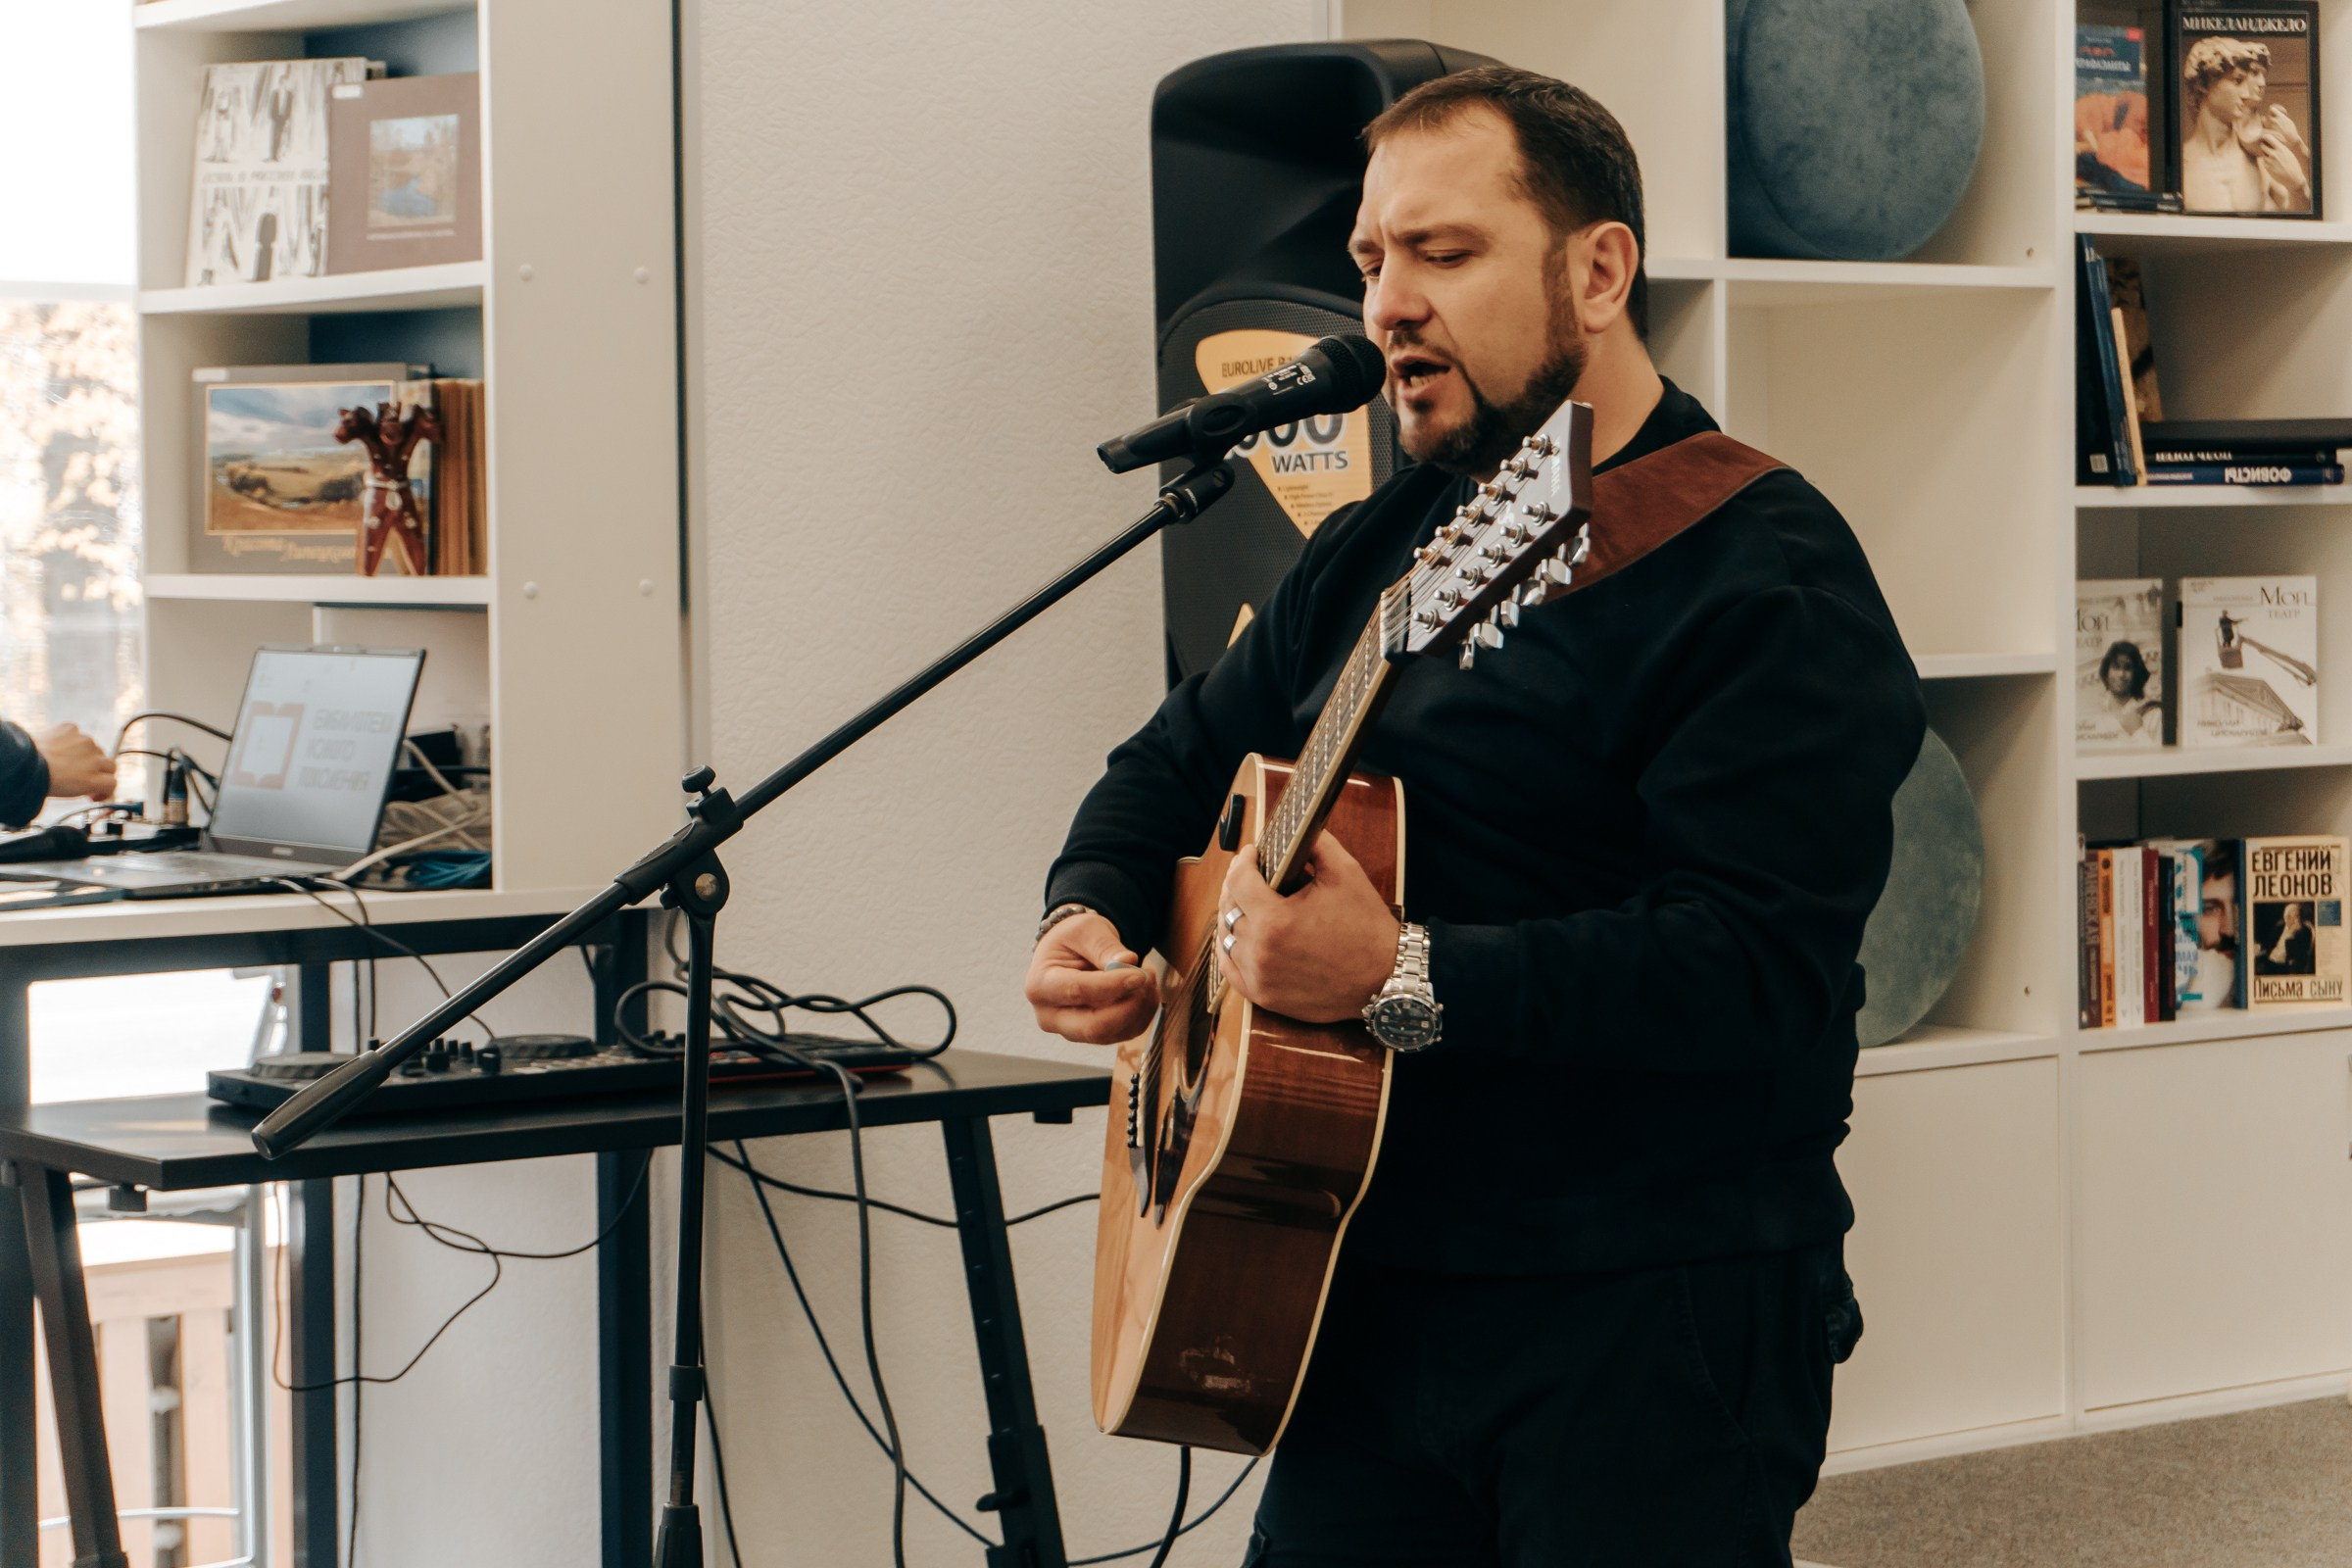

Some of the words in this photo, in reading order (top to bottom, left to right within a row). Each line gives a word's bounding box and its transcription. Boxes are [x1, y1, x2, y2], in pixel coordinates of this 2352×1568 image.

[2182, 17, 2307, 32] МИКЕЛАНДЖЕЛО
[1221, 357, 1274, 378] EUROLIVE
[1272, 450, 1348, 473] WATTS
[2224, 466, 2293, 483] ФОВИСТЫ
[2251, 845, 2331, 873] ЕВГЕНИЙ
[2253, 873, 2333, 898] ЛЕОНОВ
[2254, 978, 2303, 998] Письма
[2309, 979, 2343, 998] сыну
